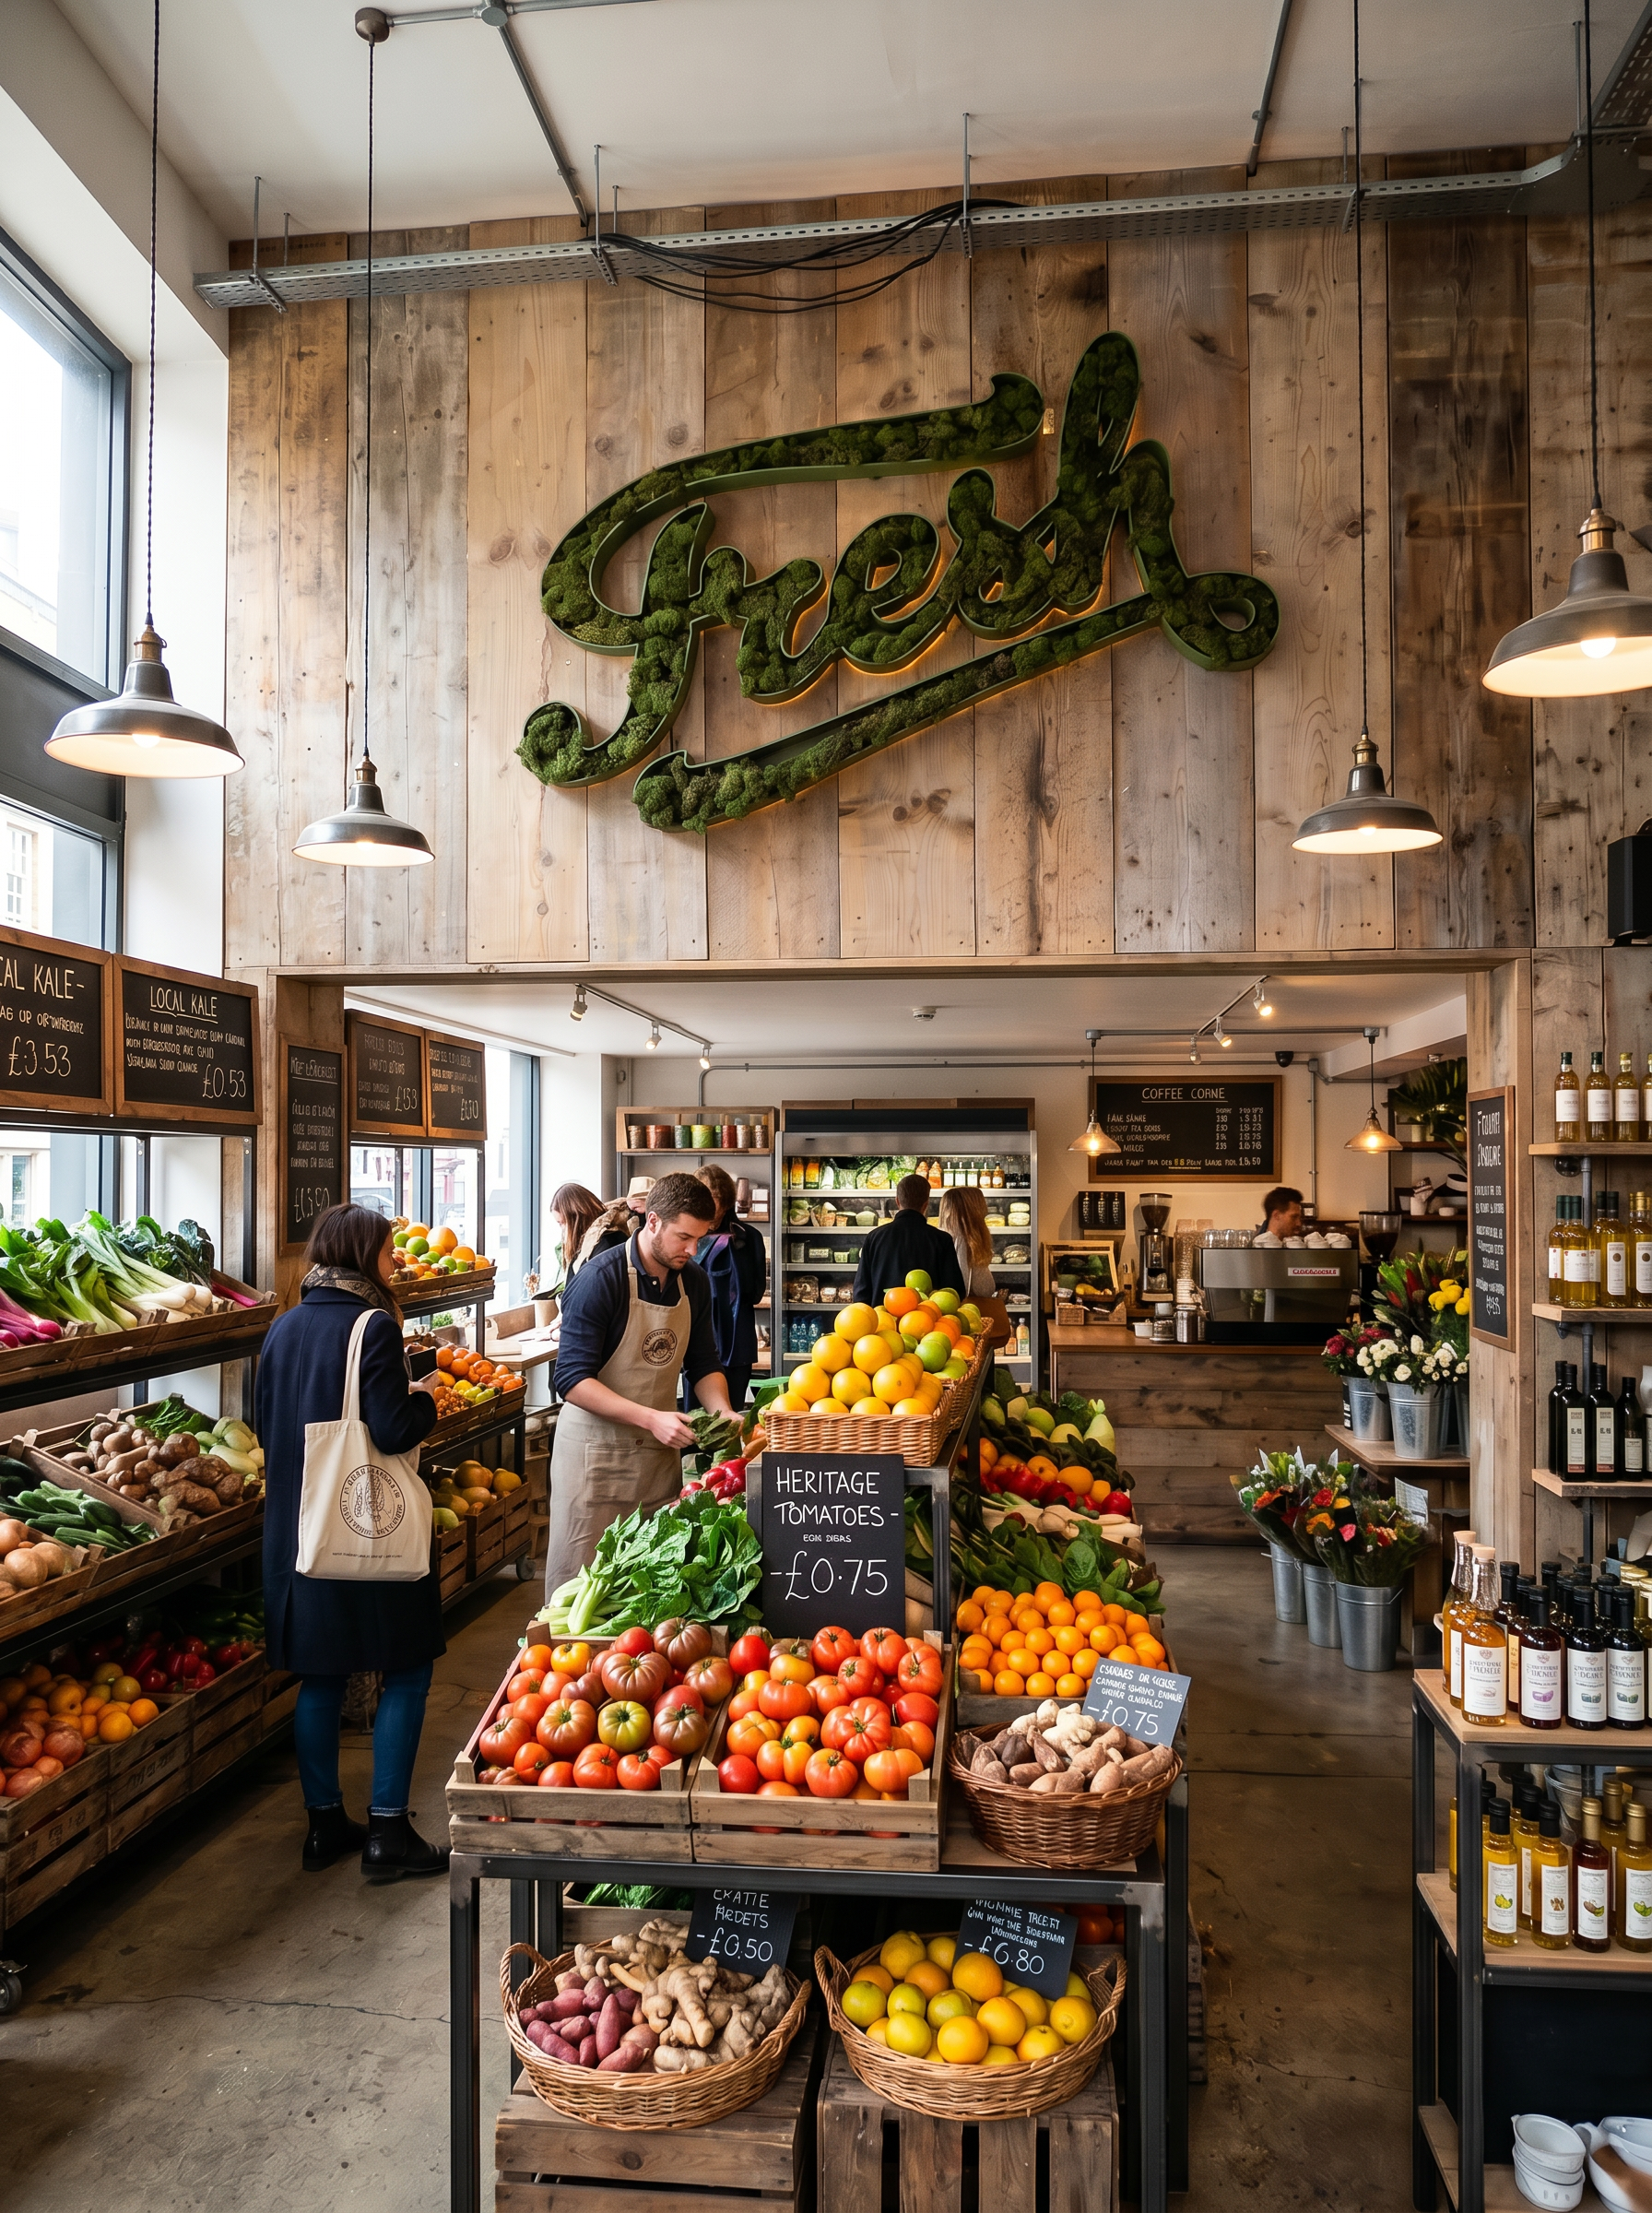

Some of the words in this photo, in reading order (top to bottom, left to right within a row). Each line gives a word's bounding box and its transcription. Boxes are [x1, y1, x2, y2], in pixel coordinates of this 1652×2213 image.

[513, 330, 1282, 834] Fresh
[149, 985, 186, 1013] LOCAL
[191, 993, 218, 1018] KALE
[1141, 1087, 1184, 1100] COFFEE
[1190, 1087, 1226, 1099] CORNE
[776, 1466, 880, 1495] HERITAGE
[773, 1500, 885, 1527] TOMATOES
